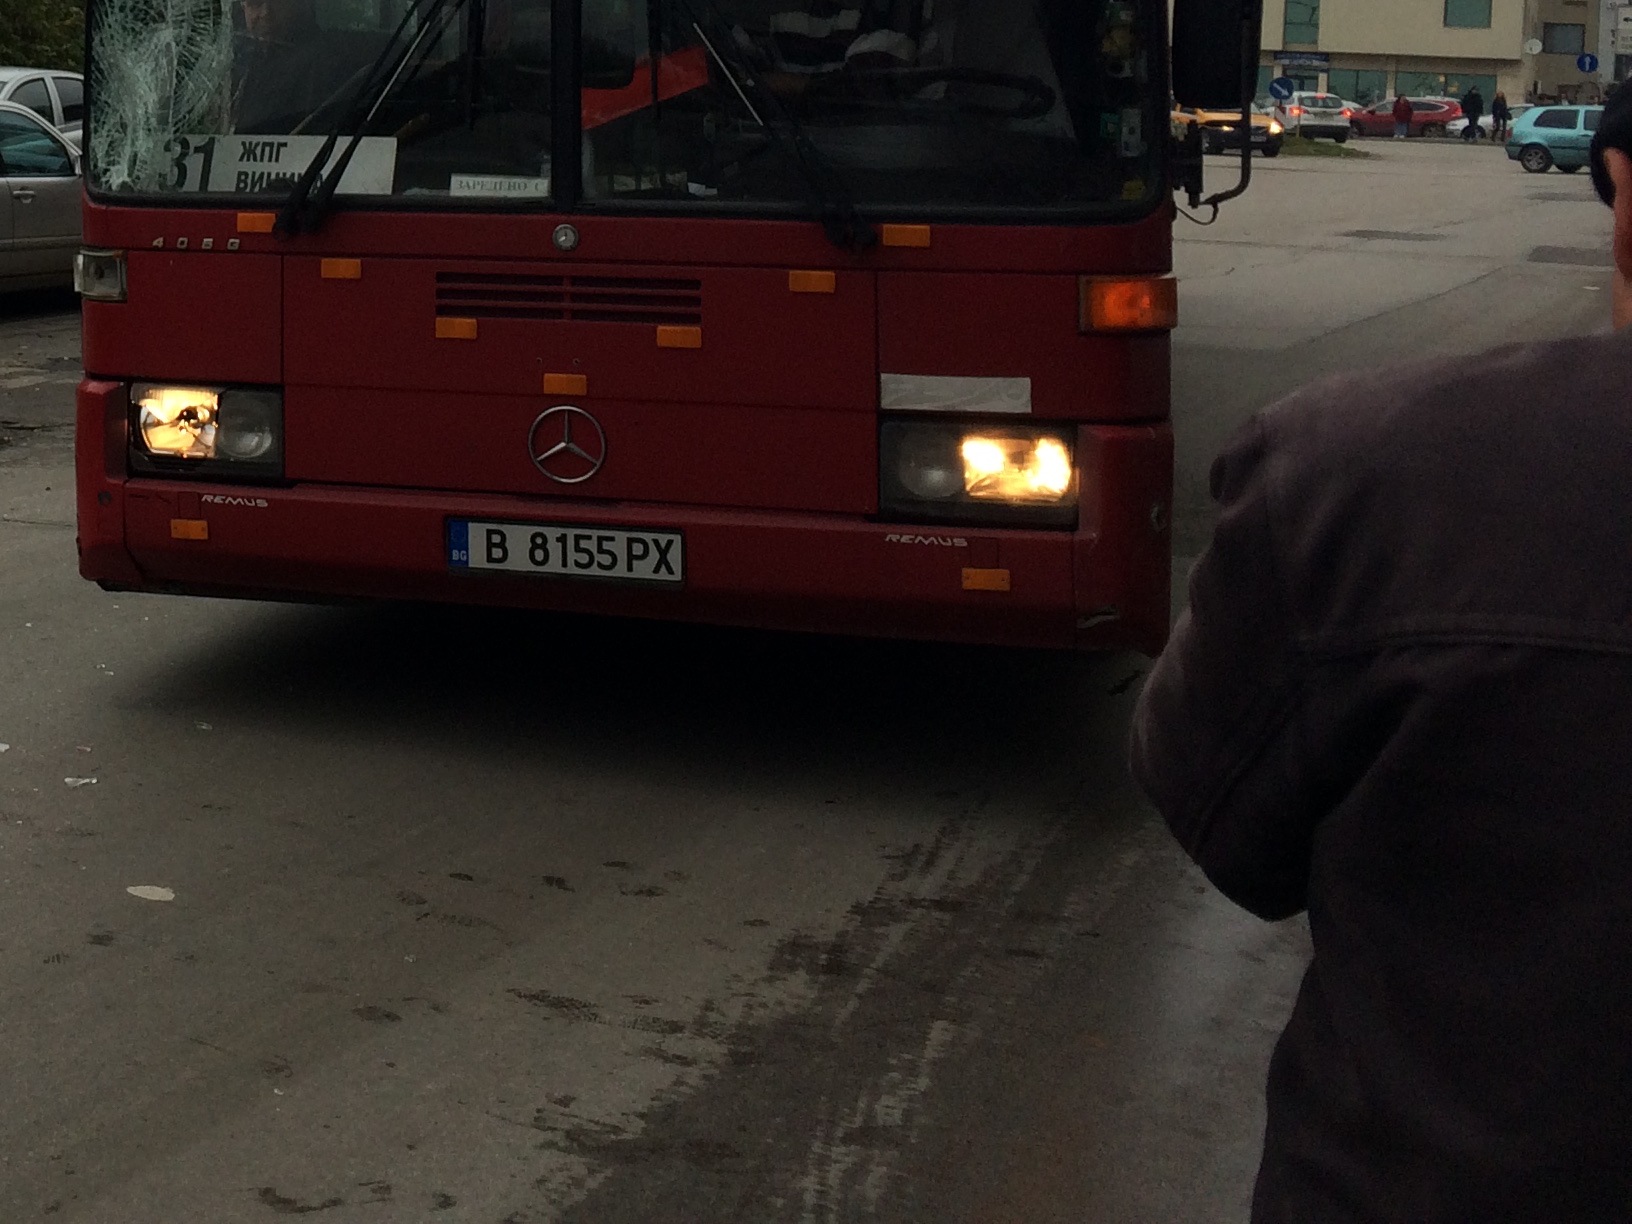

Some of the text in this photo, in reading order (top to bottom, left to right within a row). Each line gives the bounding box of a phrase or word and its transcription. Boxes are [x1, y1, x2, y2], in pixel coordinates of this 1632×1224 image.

[237, 140, 288, 163] ЖПГ
[201, 493, 269, 507] REMUS
[884, 533, 968, 546] REMUS
